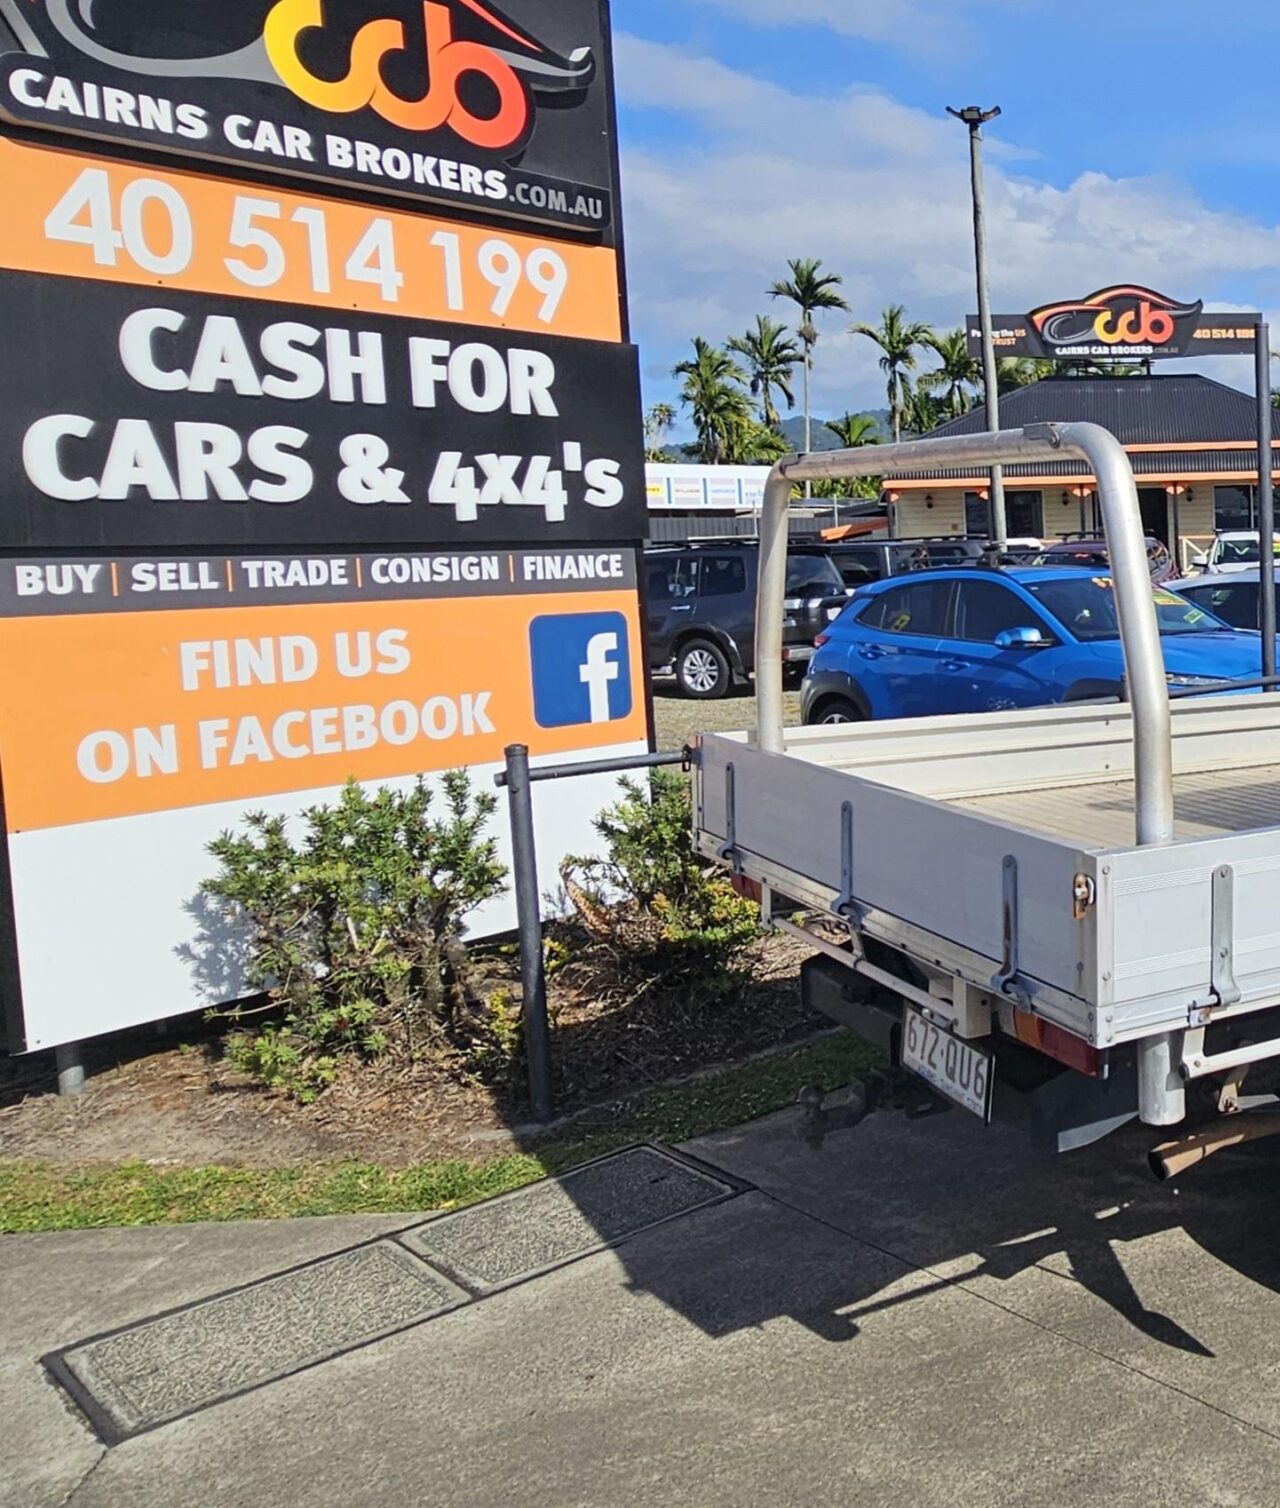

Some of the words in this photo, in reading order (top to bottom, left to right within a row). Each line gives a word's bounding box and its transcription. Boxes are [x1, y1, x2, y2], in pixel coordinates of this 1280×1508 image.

[8, 68, 208, 140] CAIRNS
[224, 114, 315, 162] CAR
[44, 167, 193, 275] 40
[223, 196, 403, 302] 514
[429, 231, 568, 324] 199
[119, 308, 387, 404] CASH
[409, 336, 559, 417] FOR
[1055, 346, 1089, 355] CAIRNS
[1091, 346, 1109, 354] CAR
[1192, 328, 1211, 339] 40
[22, 414, 314, 501] CARS
[337, 433, 411, 504] &
[15, 564, 101, 596] BUY
[130, 562, 219, 592] SELL
[241, 559, 348, 588] TRADE
[370, 555, 500, 584] CONSIGN
[523, 554, 623, 580] FINANCE
[180, 634, 318, 691] FIND
[336, 628, 411, 677] US
[579, 632, 619, 722] f
[76, 724, 178, 783] ON
[199, 691, 496, 769] FACEBOOK
